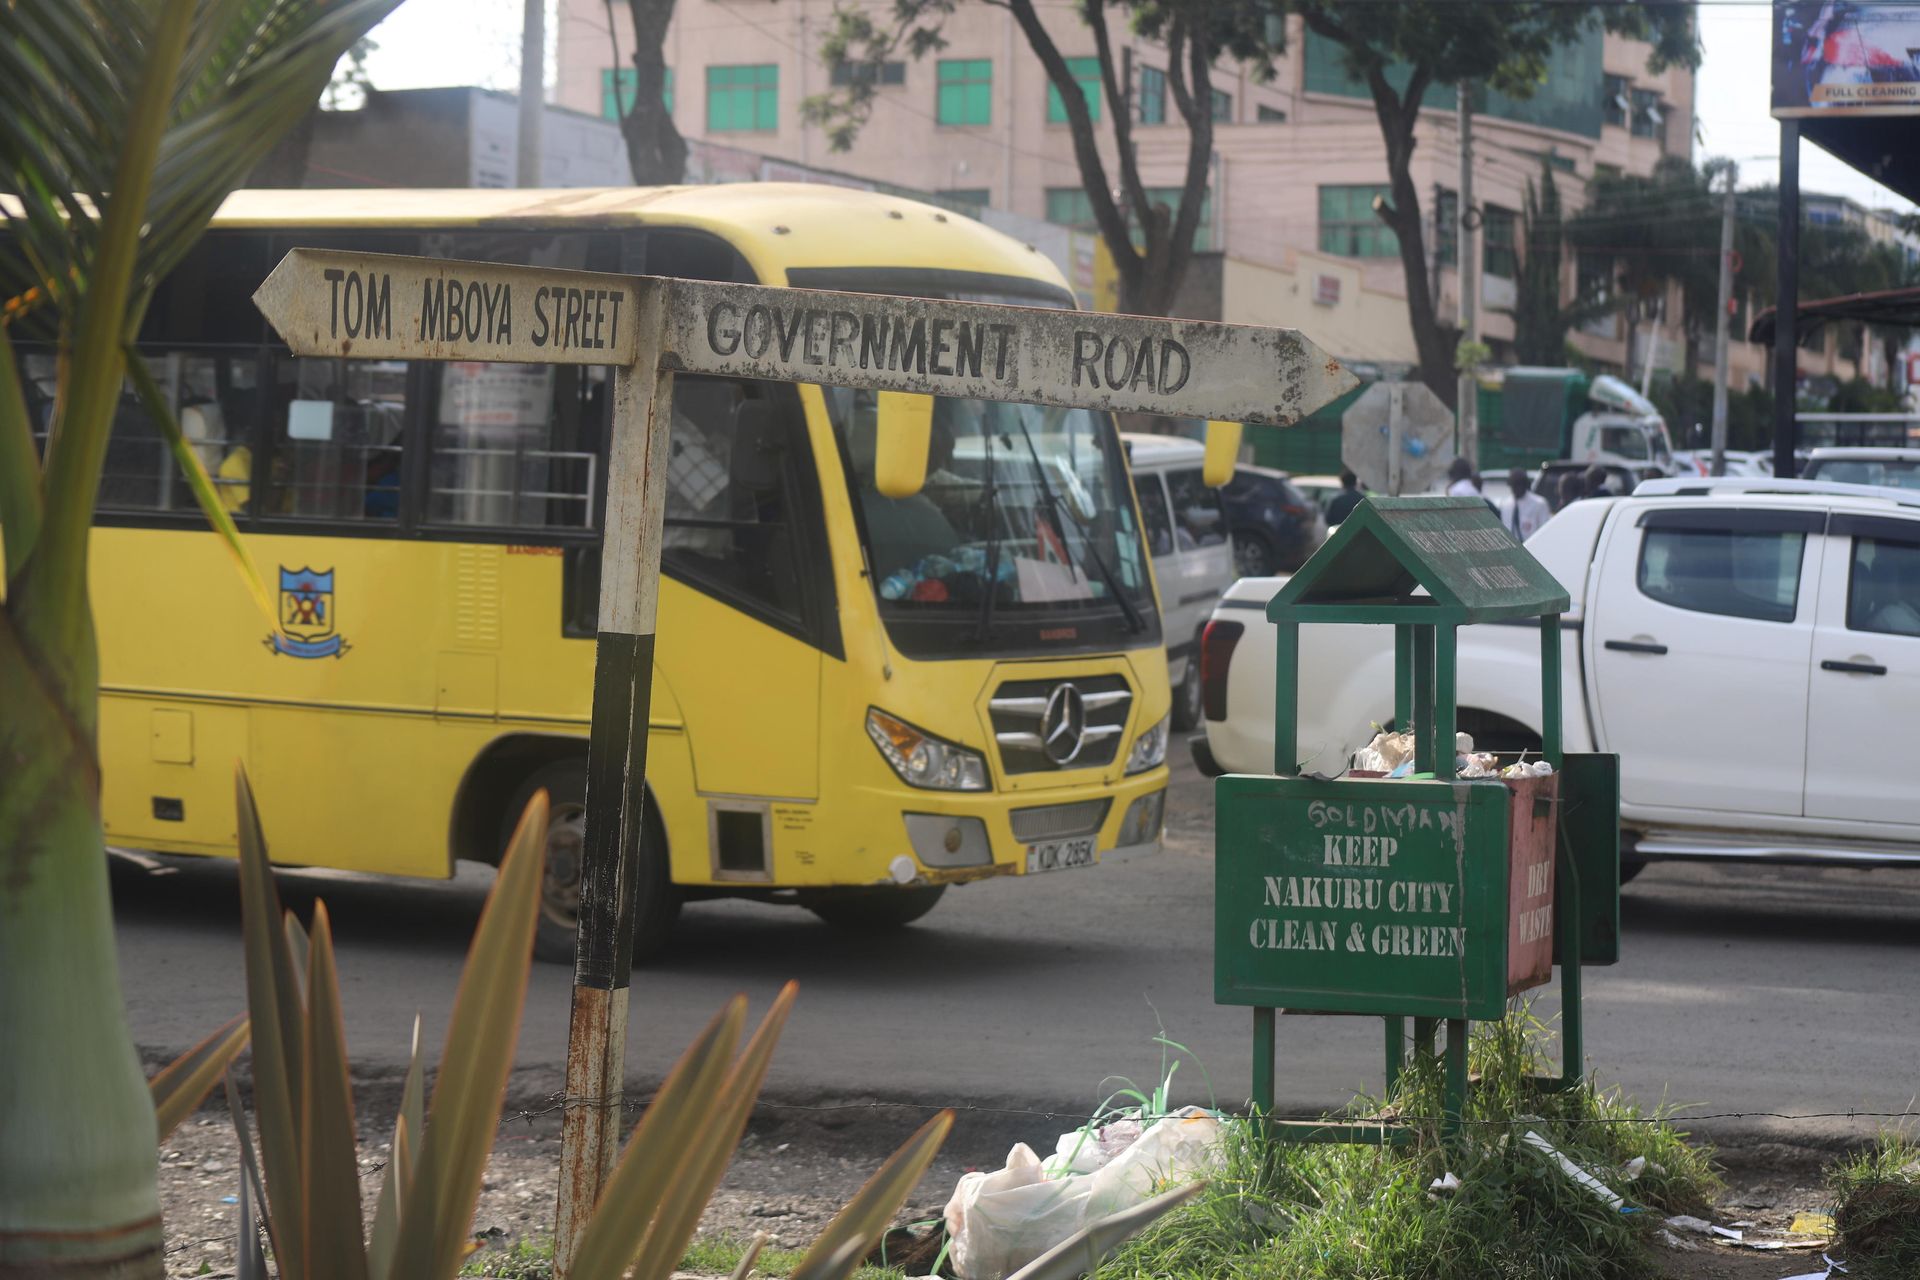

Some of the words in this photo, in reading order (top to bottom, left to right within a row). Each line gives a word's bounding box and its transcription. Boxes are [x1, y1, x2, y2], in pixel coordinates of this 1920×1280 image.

[1825, 87, 1853, 98] FULL
[1856, 85, 1917, 97] CLEANING
[324, 268, 392, 341] TOM
[420, 277, 512, 346] MBOYA
[531, 285, 624, 350] STREET
[706, 300, 1016, 380] GOVERNMENT
[1072, 330, 1191, 396] ROAD
[1322, 833, 1398, 867] KEEP
[1263, 875, 1383, 910] NAKURU
[1388, 880, 1455, 914] CITY
[1527, 860, 1550, 898] DRY
[1249, 917, 1337, 951] CLEAN
[1345, 921, 1366, 953] &
[1371, 925, 1467, 957] GREEN
[1519, 903, 1552, 945] WASTE
